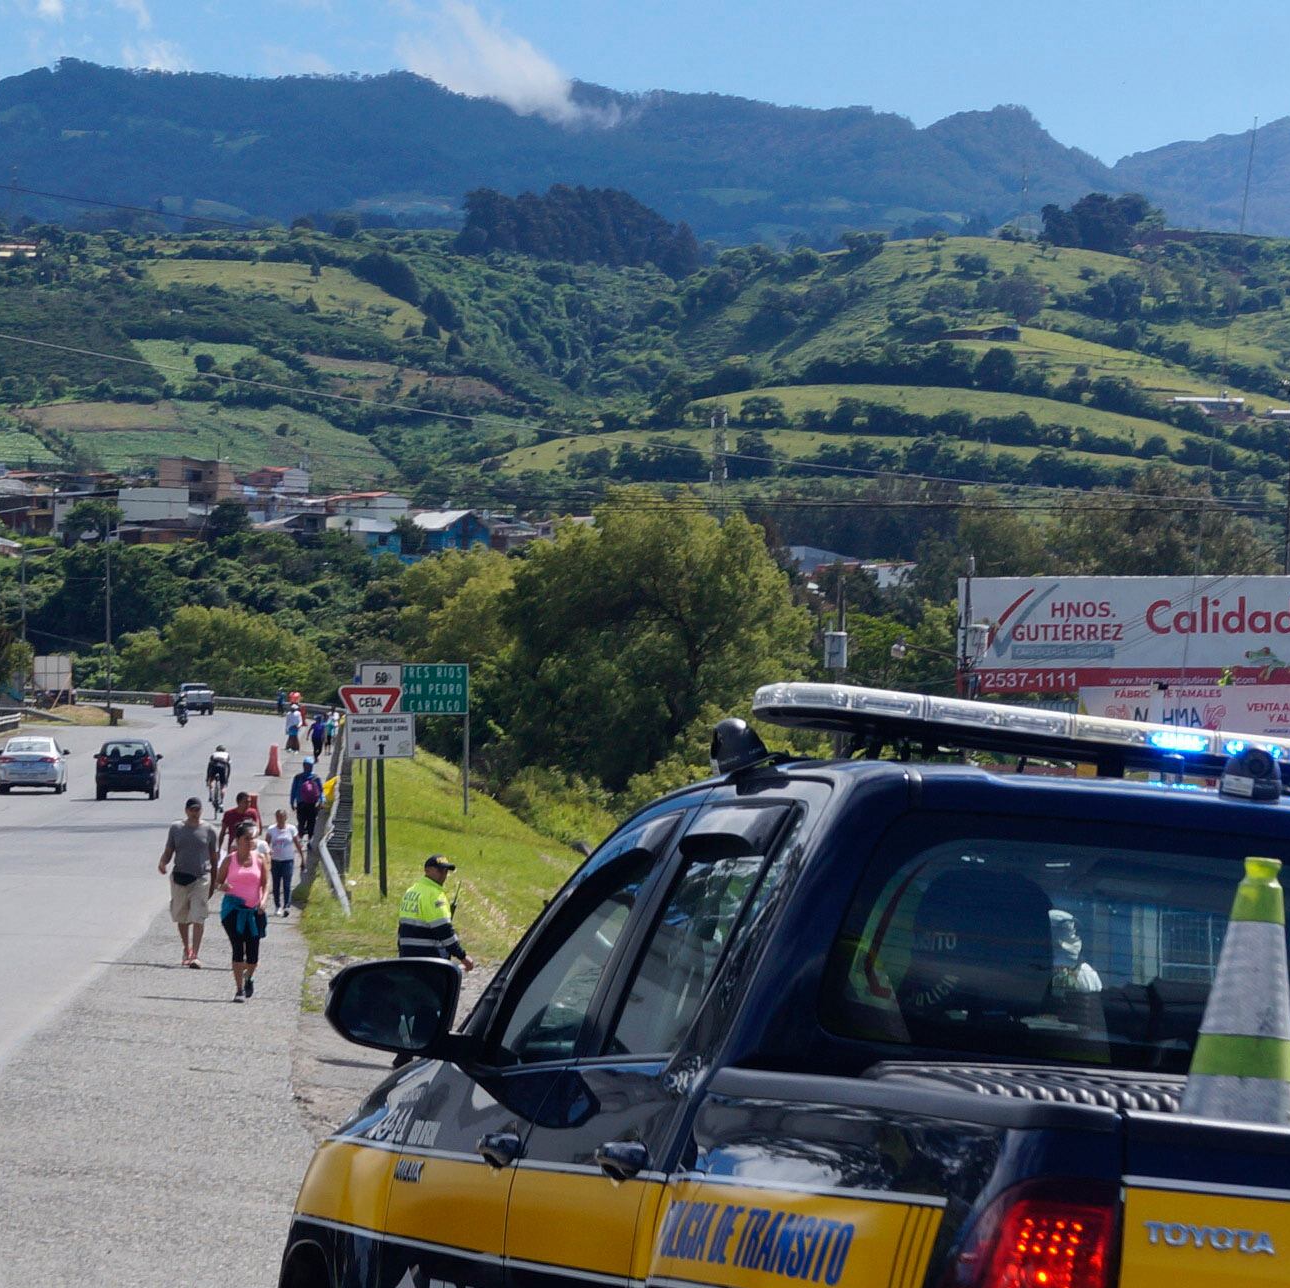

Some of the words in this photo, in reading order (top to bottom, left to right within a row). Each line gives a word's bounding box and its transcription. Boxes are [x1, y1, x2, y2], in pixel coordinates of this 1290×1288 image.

[1011, 619, 1123, 641] GUTIÉRREZ
[402, 666, 430, 679] TRES
[436, 666, 464, 679] RIOS
[985, 672, 1076, 688] 2537-1111
[404, 683, 422, 695] SAN
[429, 683, 463, 696] PEDRO
[1114, 687, 1151, 698] FÁBRIC
[1175, 688, 1222, 698] TAMALES
[359, 697, 383, 708] CEDA
[409, 699, 461, 712] CARTAGO
[1247, 702, 1280, 711] VENTA
[1268, 713, 1276, 722] Y
[1276, 713, 1289, 722] AL
[1144, 1221, 1275, 1255] TOYOTA
[707, 1205, 745, 1265] DE
[733, 1207, 855, 1287] TRANSITO
